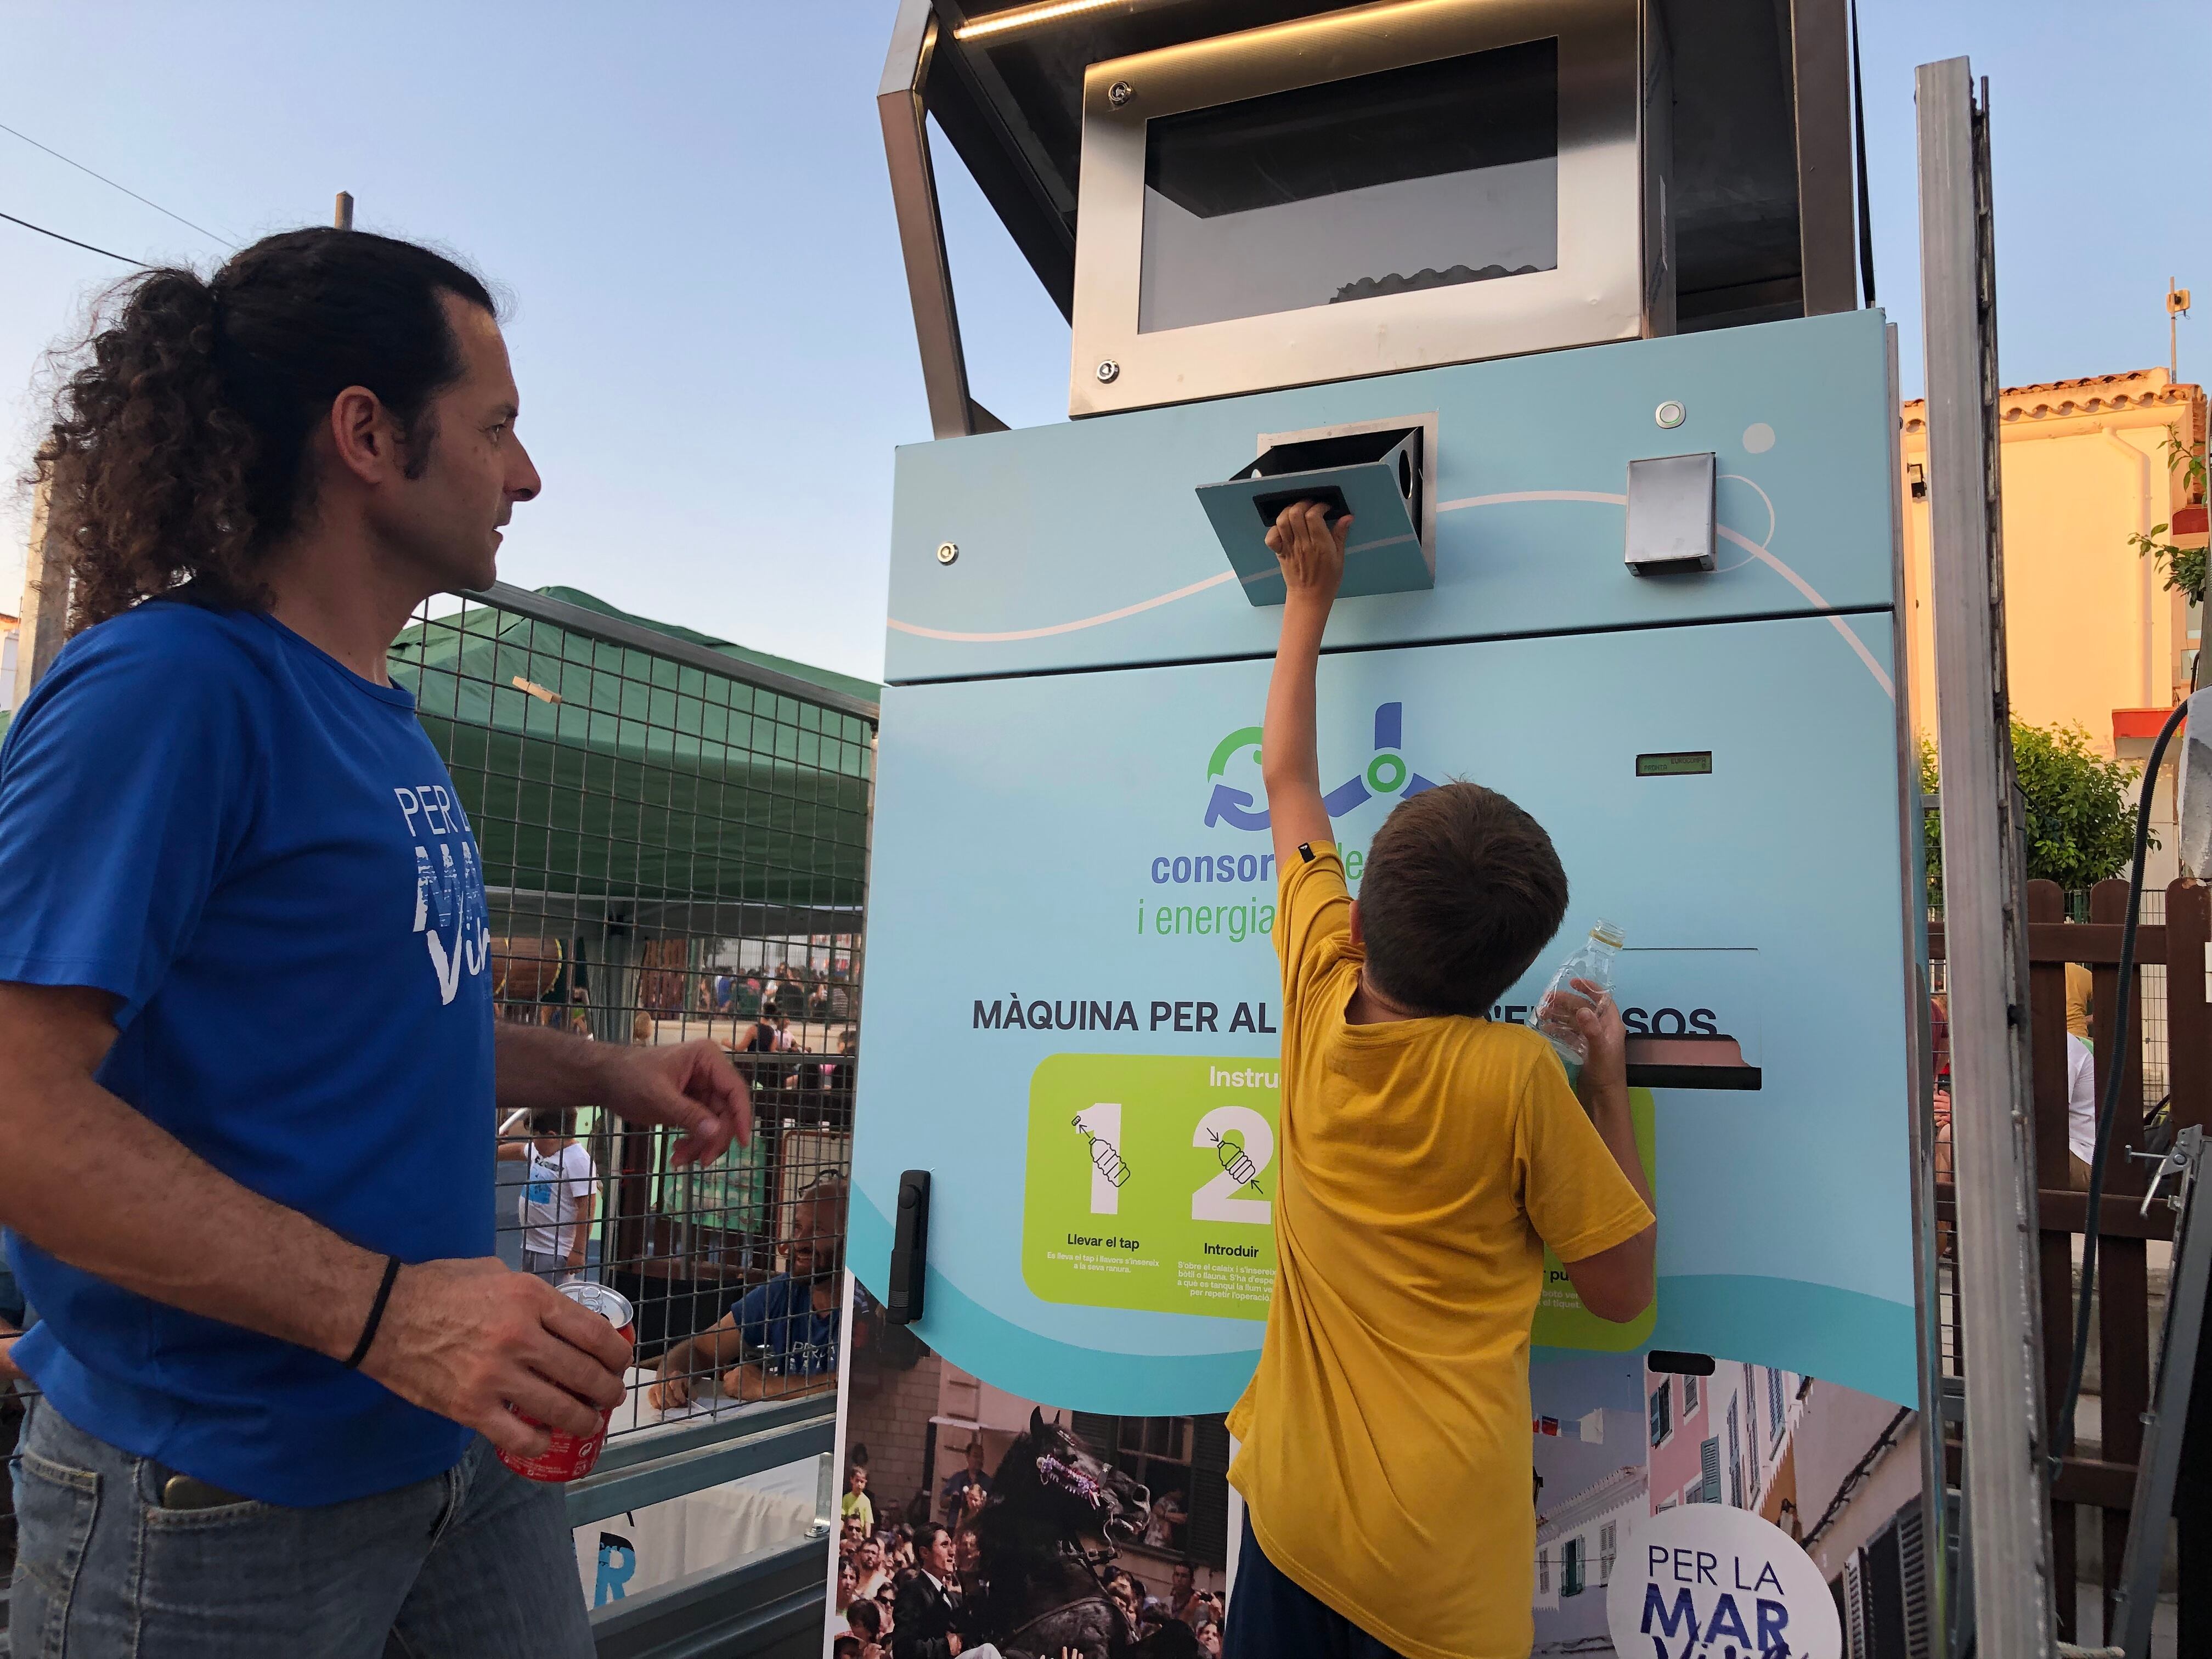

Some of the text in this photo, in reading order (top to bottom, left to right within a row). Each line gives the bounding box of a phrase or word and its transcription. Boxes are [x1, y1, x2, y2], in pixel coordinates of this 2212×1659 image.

[394, 785, 471, 837] PER L
[1152, 854, 1275, 884] consor
[413, 842, 487, 932] MA
[1138, 896, 1276, 943] i energia
[973, 992, 1139, 1031] MÀQUINA
[1150, 1001, 1218, 1032] PER
[1228, 1002, 1277, 1034] AL
[1210, 1066, 1280, 1088] Instru
[1076, 1103, 1274, 1225] 1 2
[1068, 1233, 1139, 1251] Llevar el tap
[1204, 1243, 1259, 1257] Introduir
[1057, 1252, 1073, 1261] lleva
[1083, 1255, 1094, 1263] tap
[1100, 1255, 1123, 1264] llavors
[1125, 1257, 1159, 1267] s'insereix
[1178, 1261, 1201, 1269] S'obre
[1203, 1272, 1227, 1280] llauna.
[1229, 1274, 1246, 1282] S'ha
[1248, 1275, 1273, 1284] d'espe
[1211, 1282, 1234, 1291] tanqui
[1245, 1284, 1261, 1292] llum
[1550, 1271, 1568, 1283] pu
[1205, 1290, 1230, 1299] repetir
[1648, 1545, 1785, 1595] PER LA
[1640, 1583, 1789, 1652] MAR
